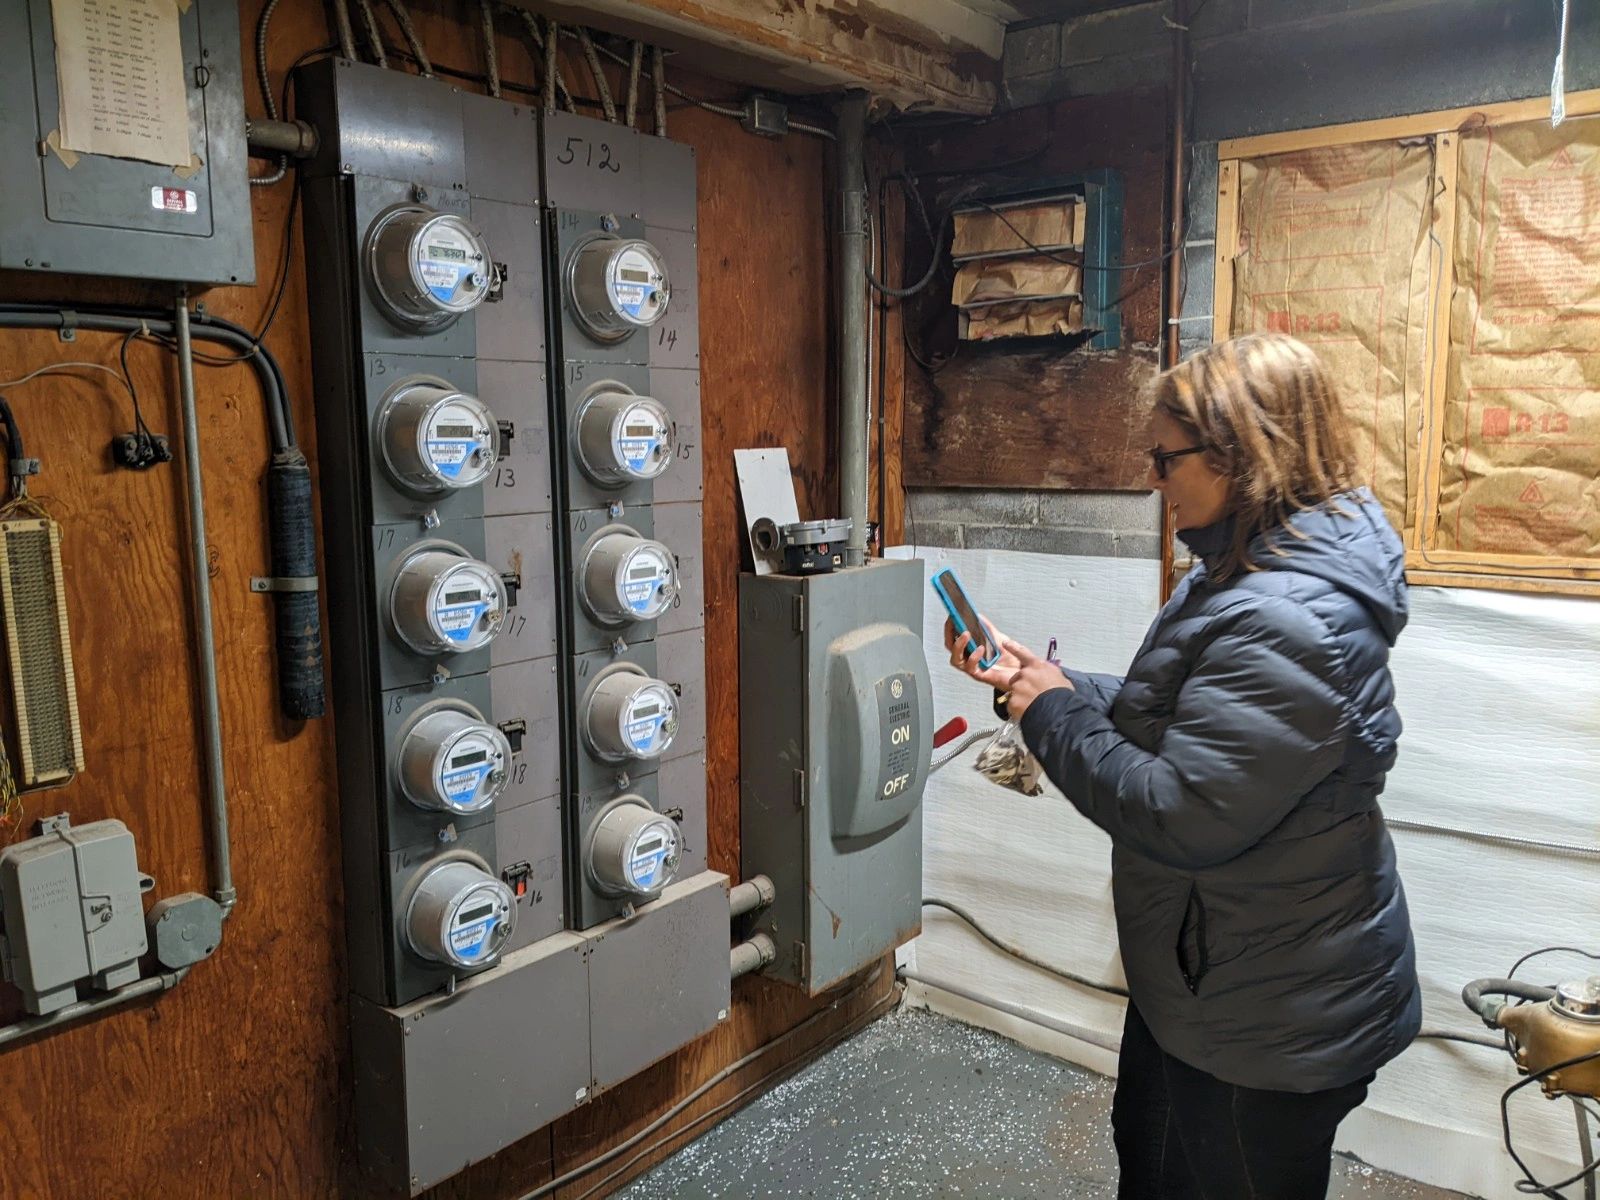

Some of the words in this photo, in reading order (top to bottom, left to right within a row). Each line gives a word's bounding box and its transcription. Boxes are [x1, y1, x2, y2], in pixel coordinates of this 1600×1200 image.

[557, 137, 620, 173] 512
[562, 211, 579, 229] 14
[659, 327, 677, 351] 14
[370, 358, 386, 378] 13
[570, 364, 585, 385] 15
[677, 442, 695, 460] 15
[495, 468, 515, 488] 13
[574, 515, 587, 532] 10
[378, 529, 395, 551] 17
[509, 615, 527, 637] 17
[578, 659, 589, 677] 11
[387, 695, 403, 716] 18
[888, 702, 909, 714] GENERAL
[889, 711, 911, 724] ELECTRIC
[891, 725, 909, 744] ON
[512, 763, 527, 784] 18
[883, 774, 909, 795] OFF
[395, 852, 411, 873] 16
[530, 889, 543, 907] 16
